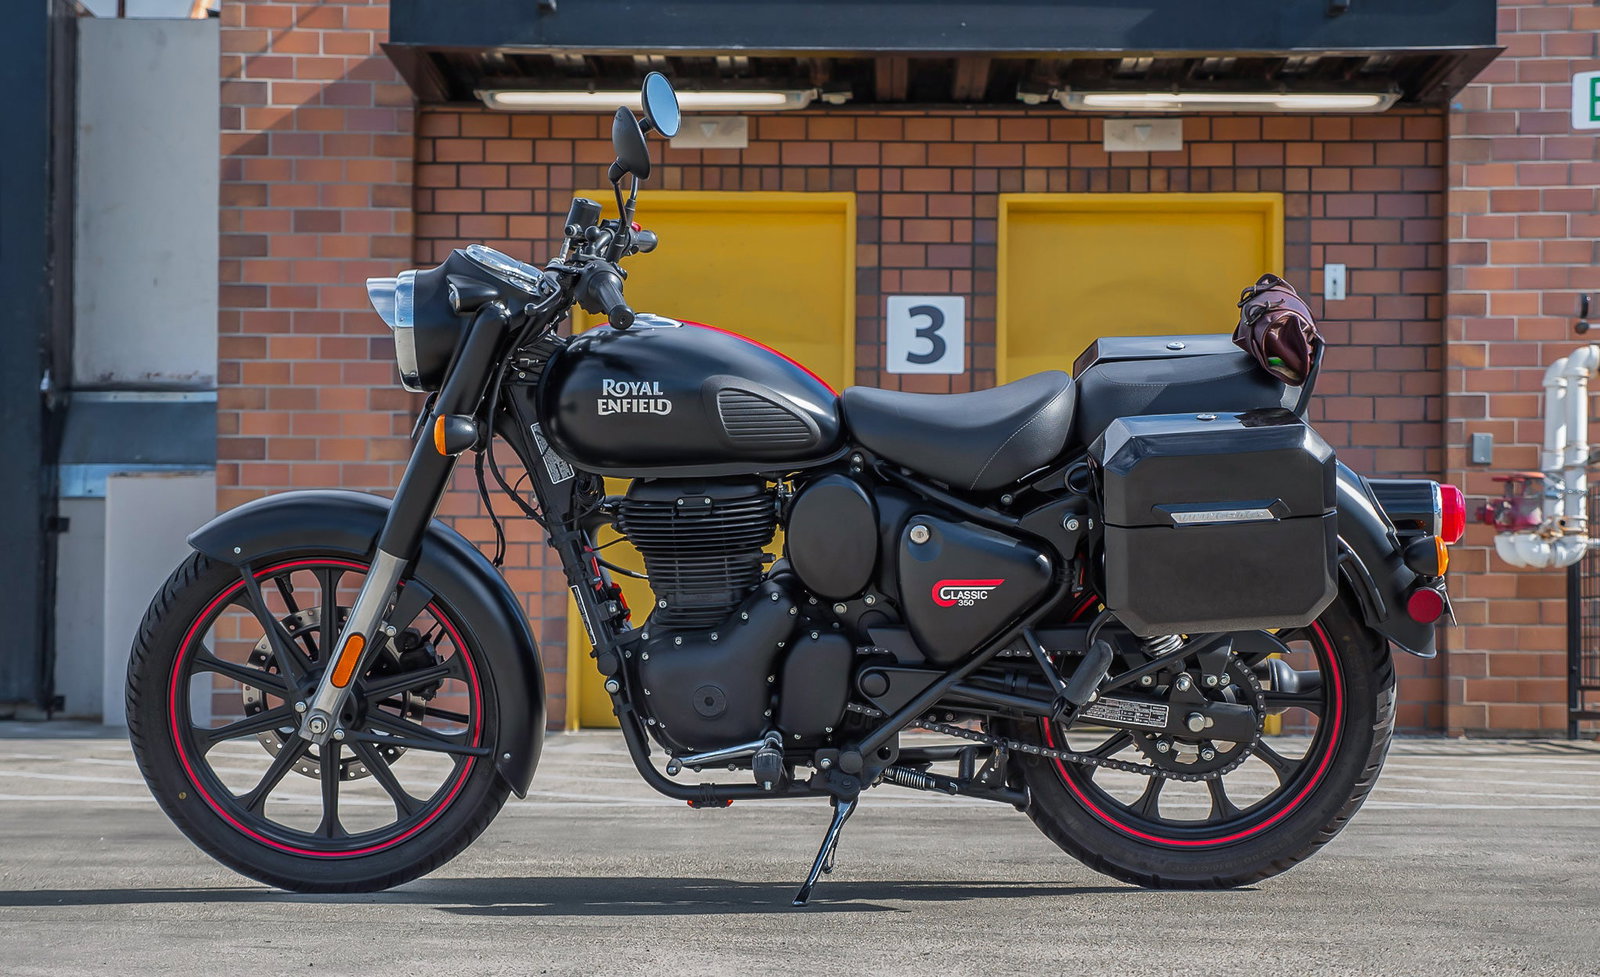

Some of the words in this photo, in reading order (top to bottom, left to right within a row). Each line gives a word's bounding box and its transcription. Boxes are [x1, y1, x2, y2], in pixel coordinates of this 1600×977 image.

[906, 305, 946, 364] 3
[602, 379, 664, 397] ROYAL
[597, 399, 672, 415] ENFIELD
[940, 586, 994, 600] CLASSIC
